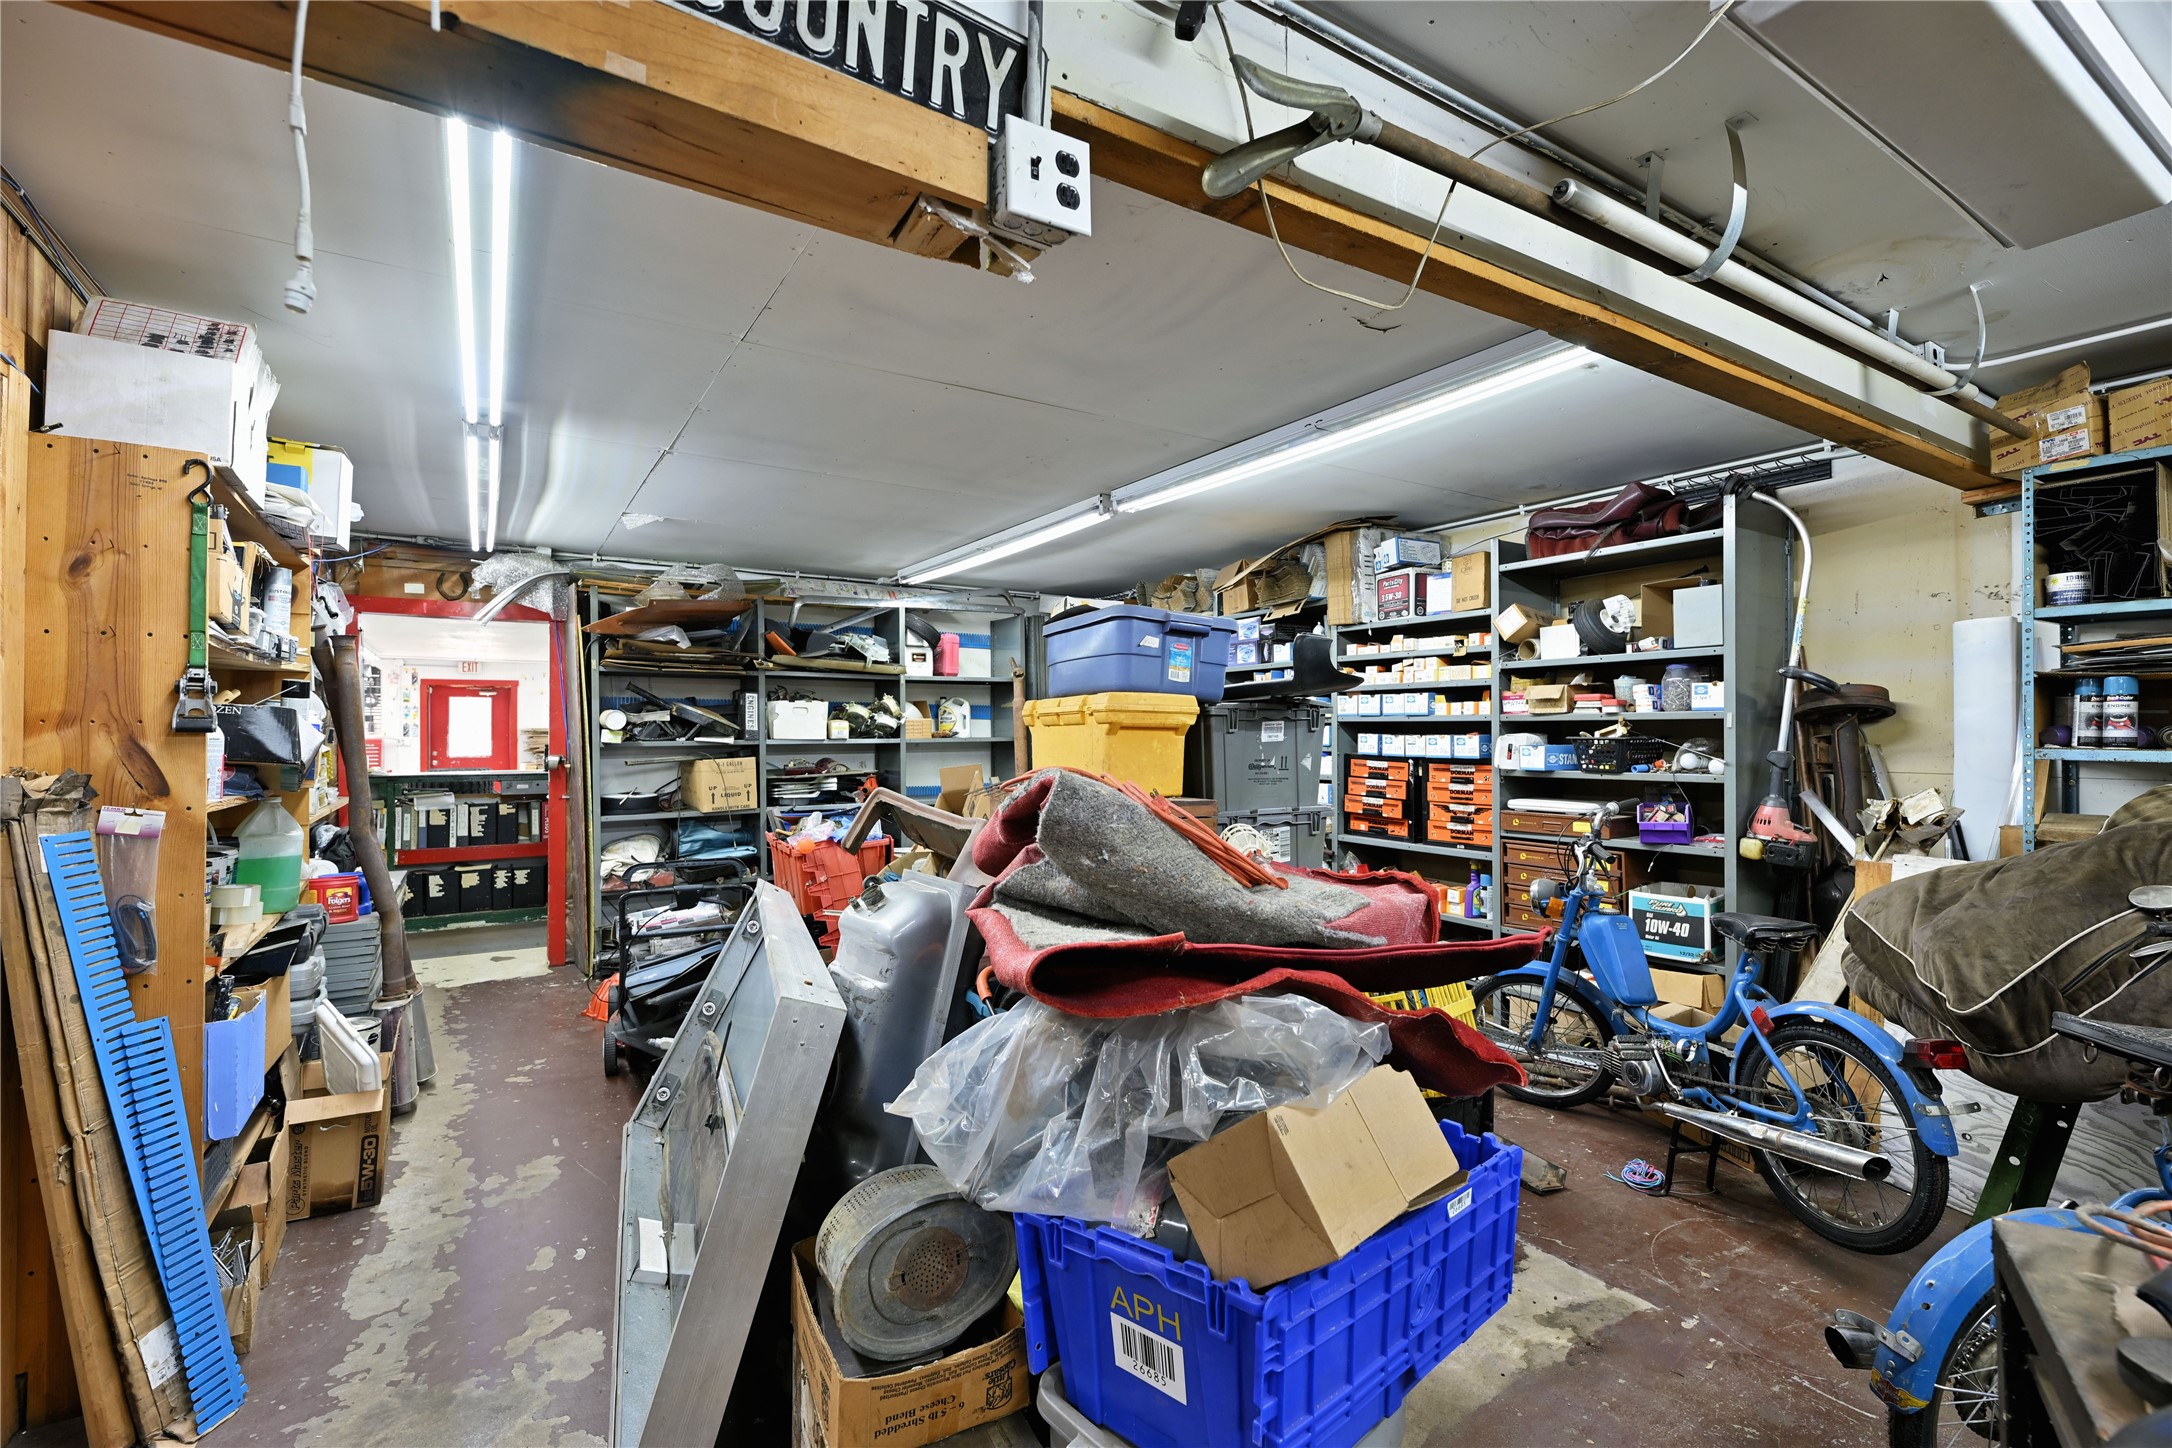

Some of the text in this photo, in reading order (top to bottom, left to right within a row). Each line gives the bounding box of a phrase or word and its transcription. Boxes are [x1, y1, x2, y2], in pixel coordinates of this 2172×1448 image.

[697, 0, 1019, 134] UNTRY
[2124, 417, 2158, 434] Compliant
[462, 661, 478, 672] EXIT
[747, 695, 755, 730] ENGINES
[1559, 753, 1578, 765] STAN
[1450, 828, 1475, 836] DORMAN
[328, 896, 351, 905] Folgers
[1645, 918, 1690, 937] 10W-40
[360, 1137, 376, 1191] 5W-30
[288, 1139, 303, 1211] Parts Master
[1110, 1286, 1182, 1341] APH
[985, 1359, 1016, 1379] Caesars
[988, 1369, 1011, 1386] Little
[1132, 1360, 1167, 1387] 26685
[885, 1395, 956, 1425] Cheese Blend
[941, 1407, 947, 1417] 5
[959, 1401, 965, 1411] 6
[927, 1411, 938, 1422] lb
[874, 1416, 925, 1440] Shredded
